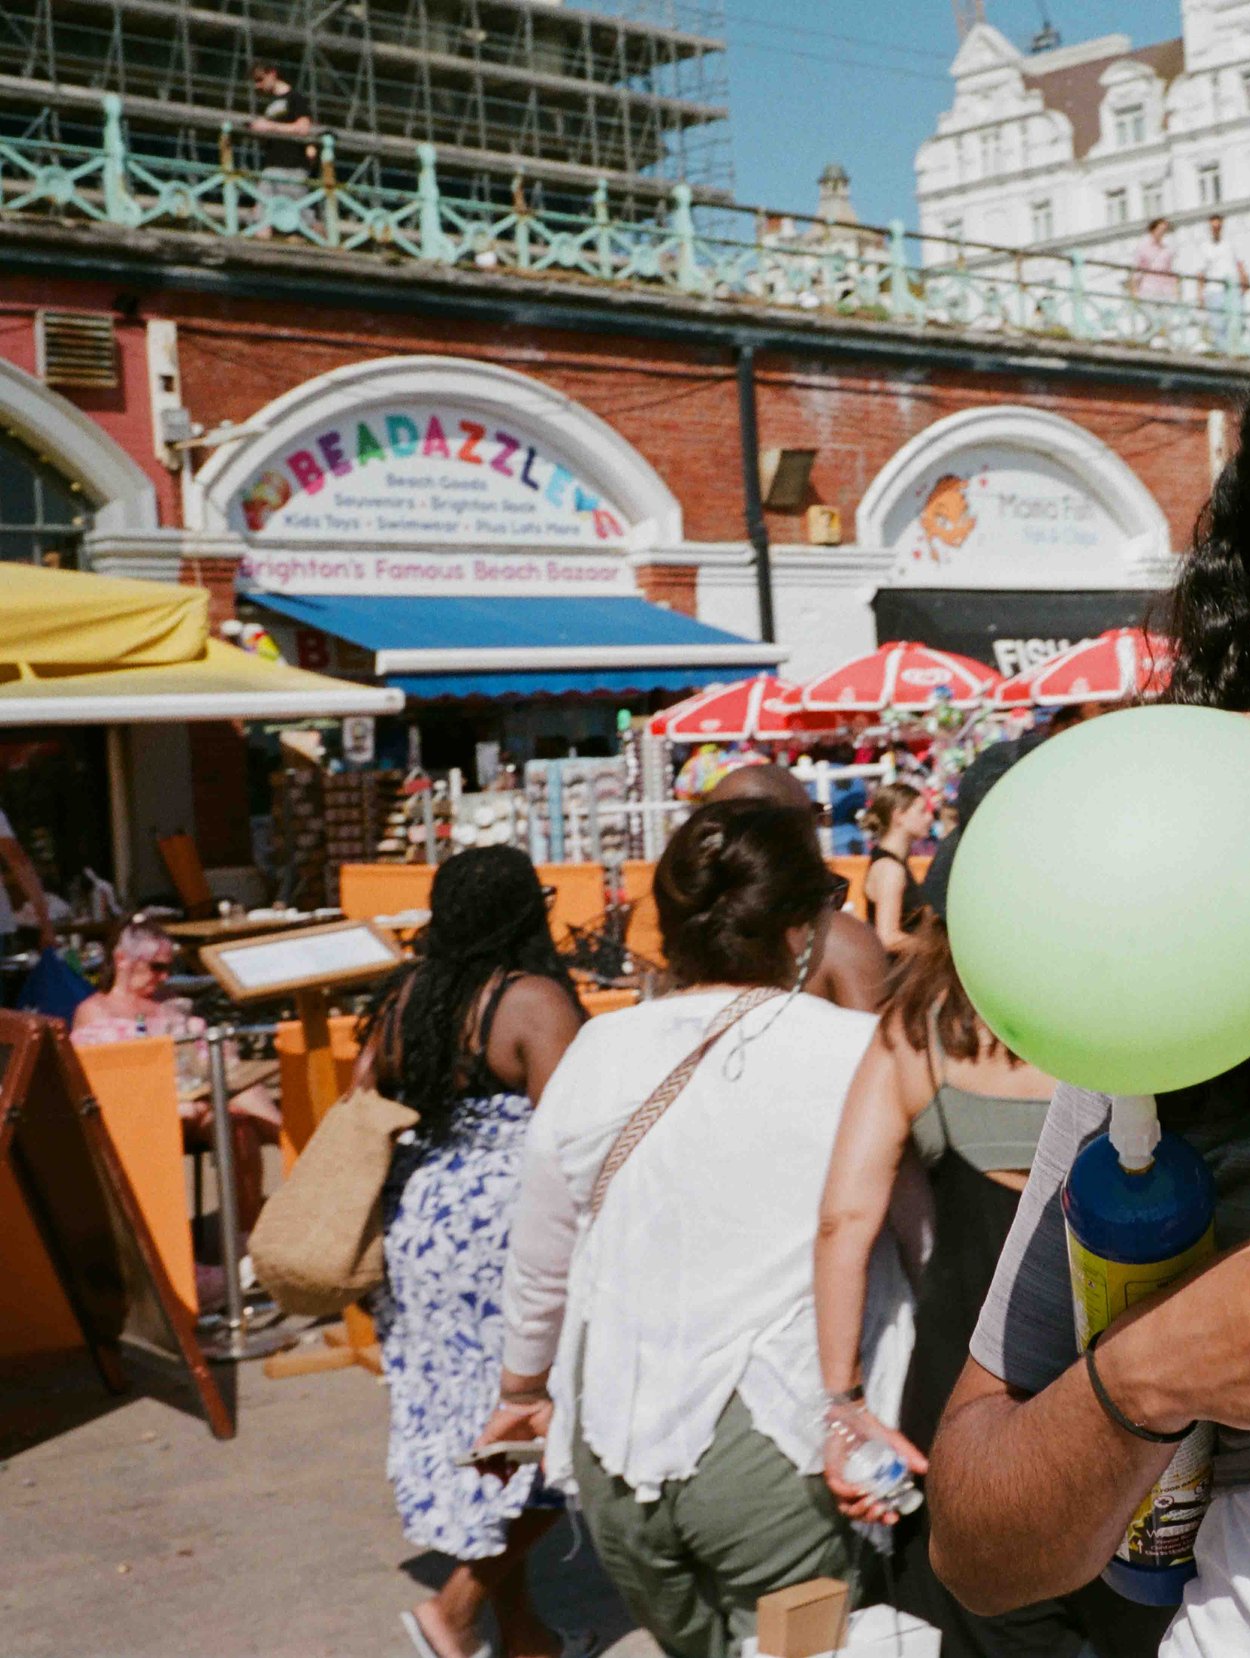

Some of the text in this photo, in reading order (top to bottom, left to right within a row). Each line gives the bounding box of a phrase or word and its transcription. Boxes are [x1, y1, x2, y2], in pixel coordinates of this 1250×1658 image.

[386, 472, 433, 488] Beach
[377, 515, 459, 532] Swimwear
[375, 557, 465, 581] Famous
[474, 559, 540, 582] Beach
[546, 560, 620, 583] Bazaar
